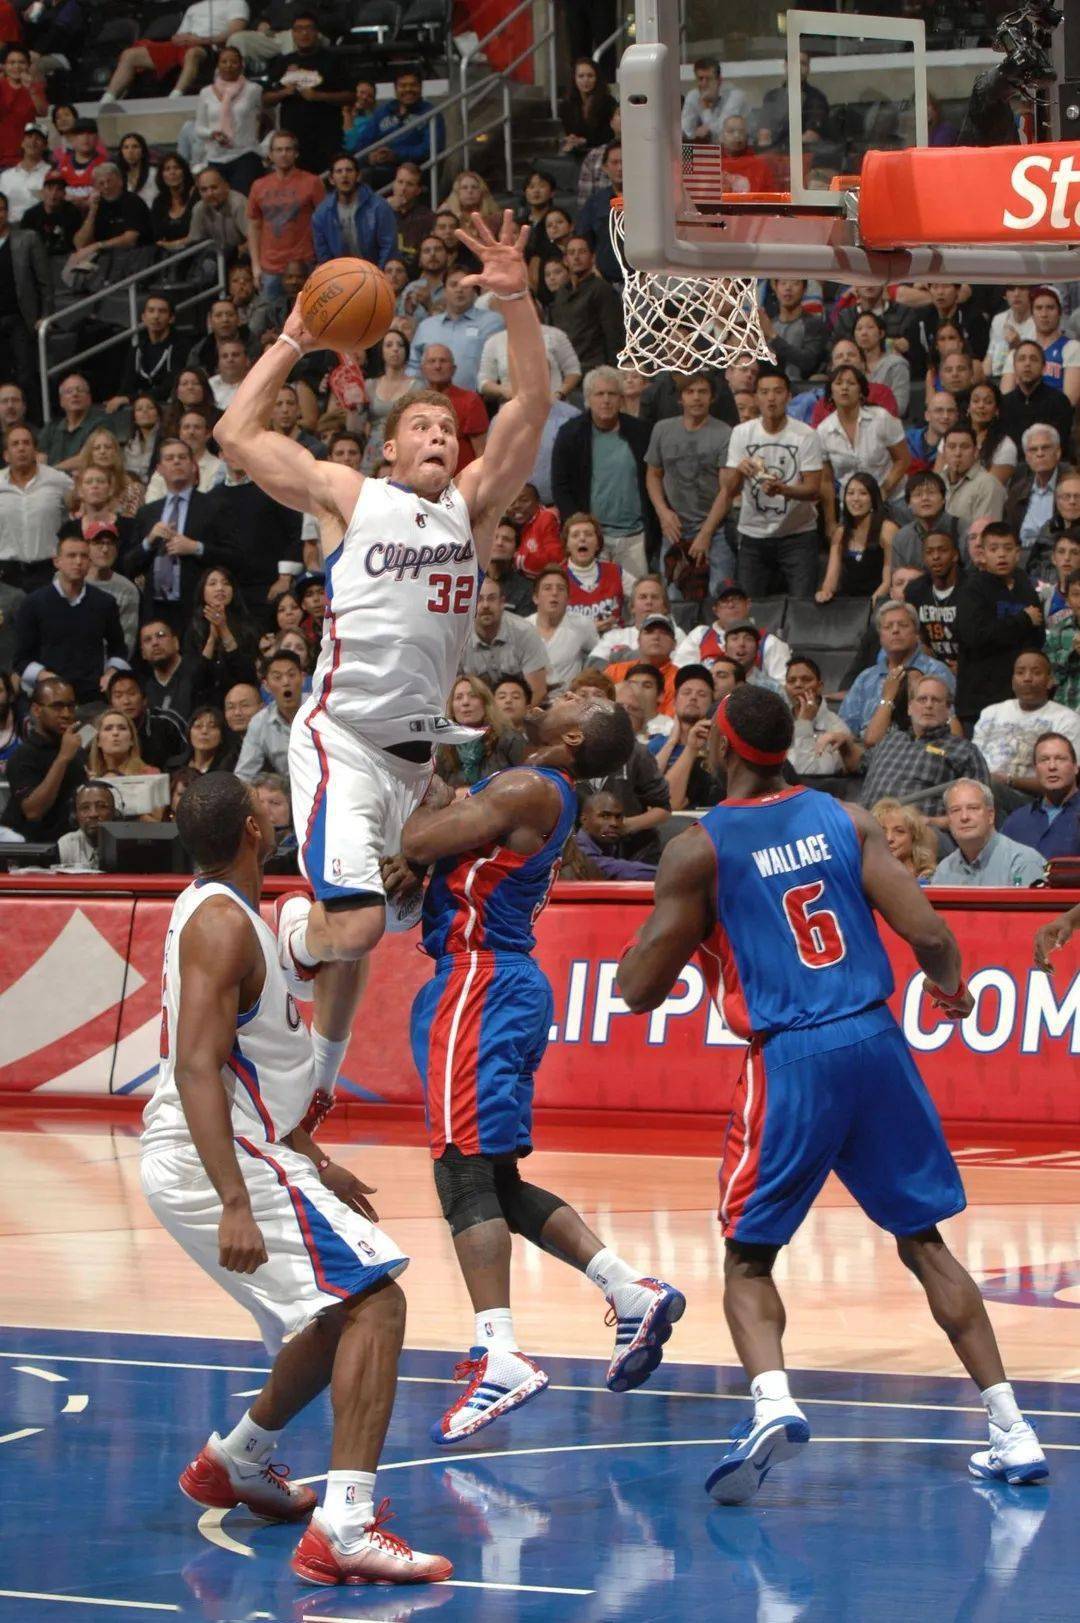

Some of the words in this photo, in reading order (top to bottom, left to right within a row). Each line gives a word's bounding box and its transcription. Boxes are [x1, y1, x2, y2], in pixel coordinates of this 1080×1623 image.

[1002, 155, 1080, 230] St
[364, 540, 474, 581] Clippers
[427, 573, 475, 614] 32
[751, 833, 832, 878] WALLACE
[782, 880, 846, 969] 6
